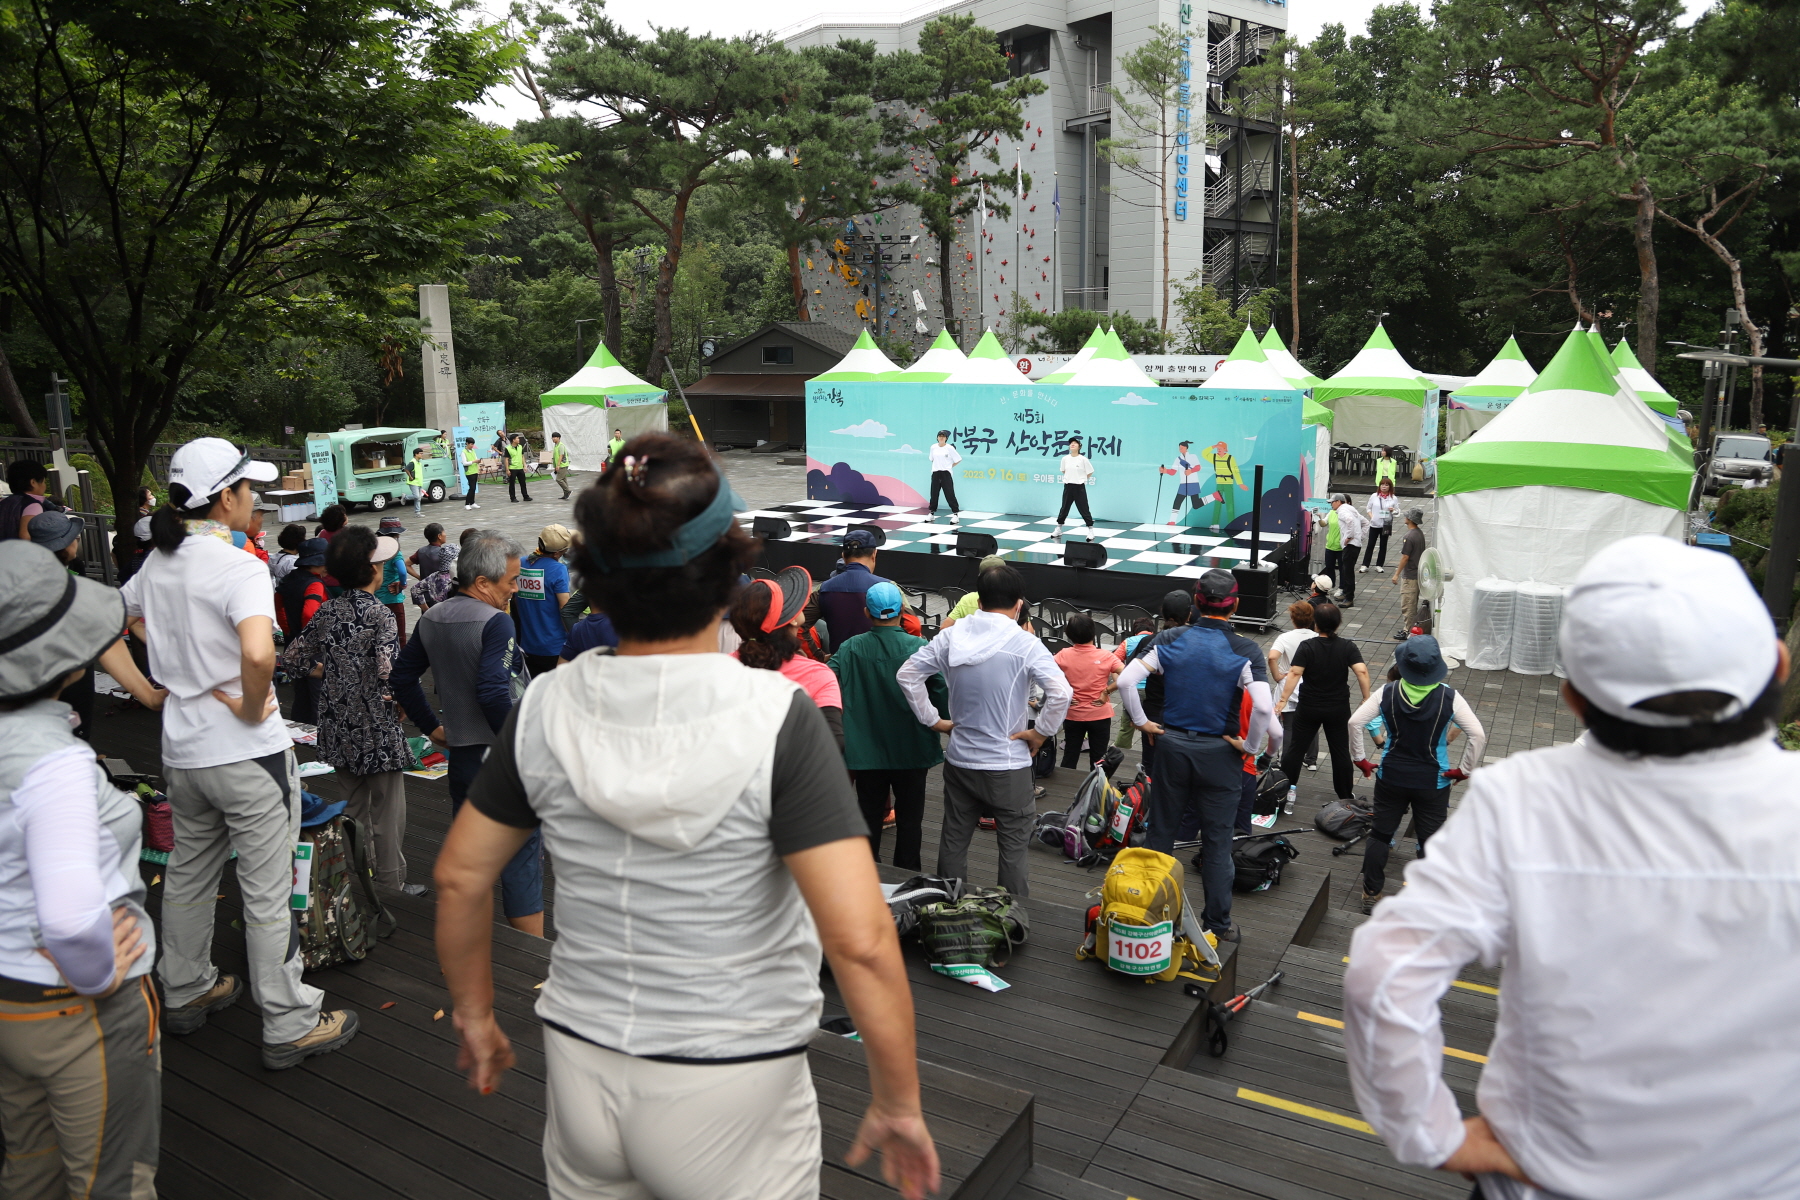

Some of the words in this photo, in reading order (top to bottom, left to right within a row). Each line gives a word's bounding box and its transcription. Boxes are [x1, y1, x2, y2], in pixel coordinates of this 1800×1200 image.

[1144, 365, 1164, 373] 함께
[1167, 365, 1207, 373] 출발해요
[1013, 408, 1044, 424] 제5회
[1006, 429, 1122, 460] 산악문화제
[1033, 473, 1055, 484] 우이동
[519, 578, 541, 590] 1083
[1128, 887, 1140, 896] K2
[1115, 940, 1162, 960] 1102
